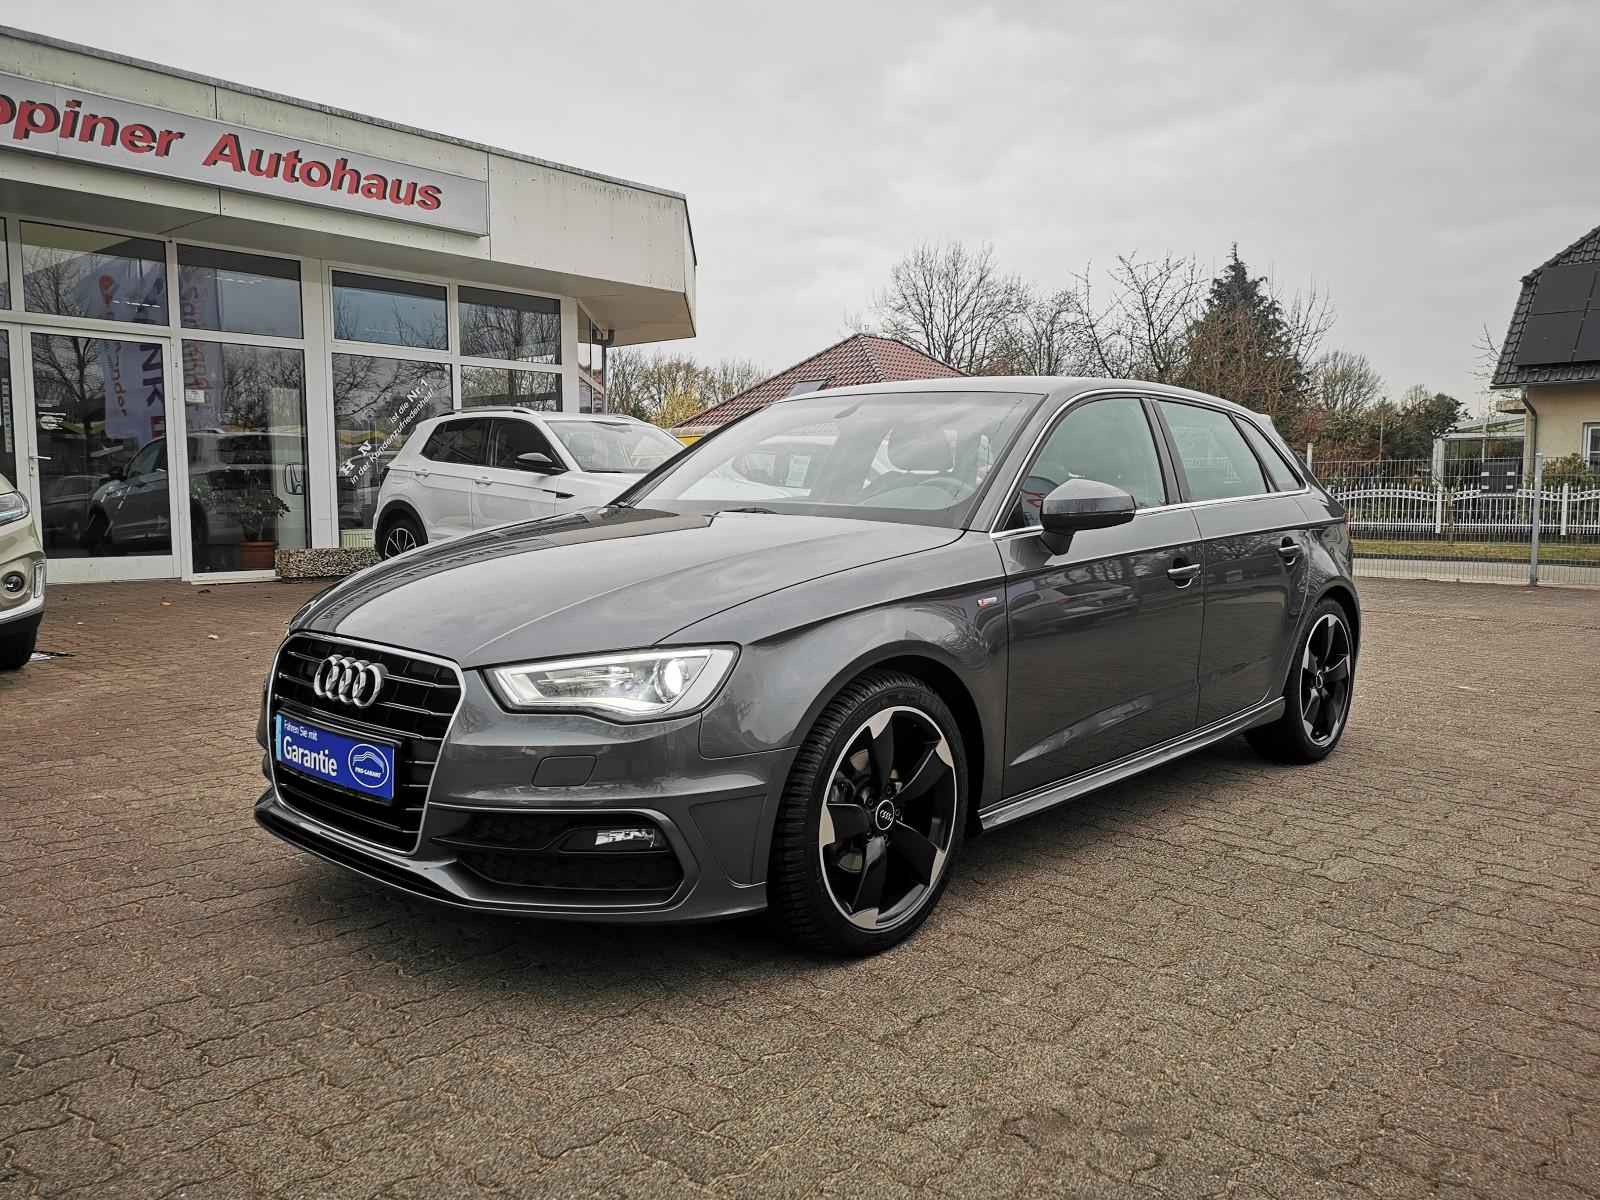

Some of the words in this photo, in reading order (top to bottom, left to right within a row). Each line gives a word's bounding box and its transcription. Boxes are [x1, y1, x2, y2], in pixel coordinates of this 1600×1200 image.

[202, 133, 442, 211] Autohaus
[398, 402, 410, 415] die
[350, 474, 359, 485] in
[358, 460, 370, 476] der
[299, 725, 308, 738] Sie
[308, 730, 318, 742] mit
[283, 735, 338, 777] Garantie
